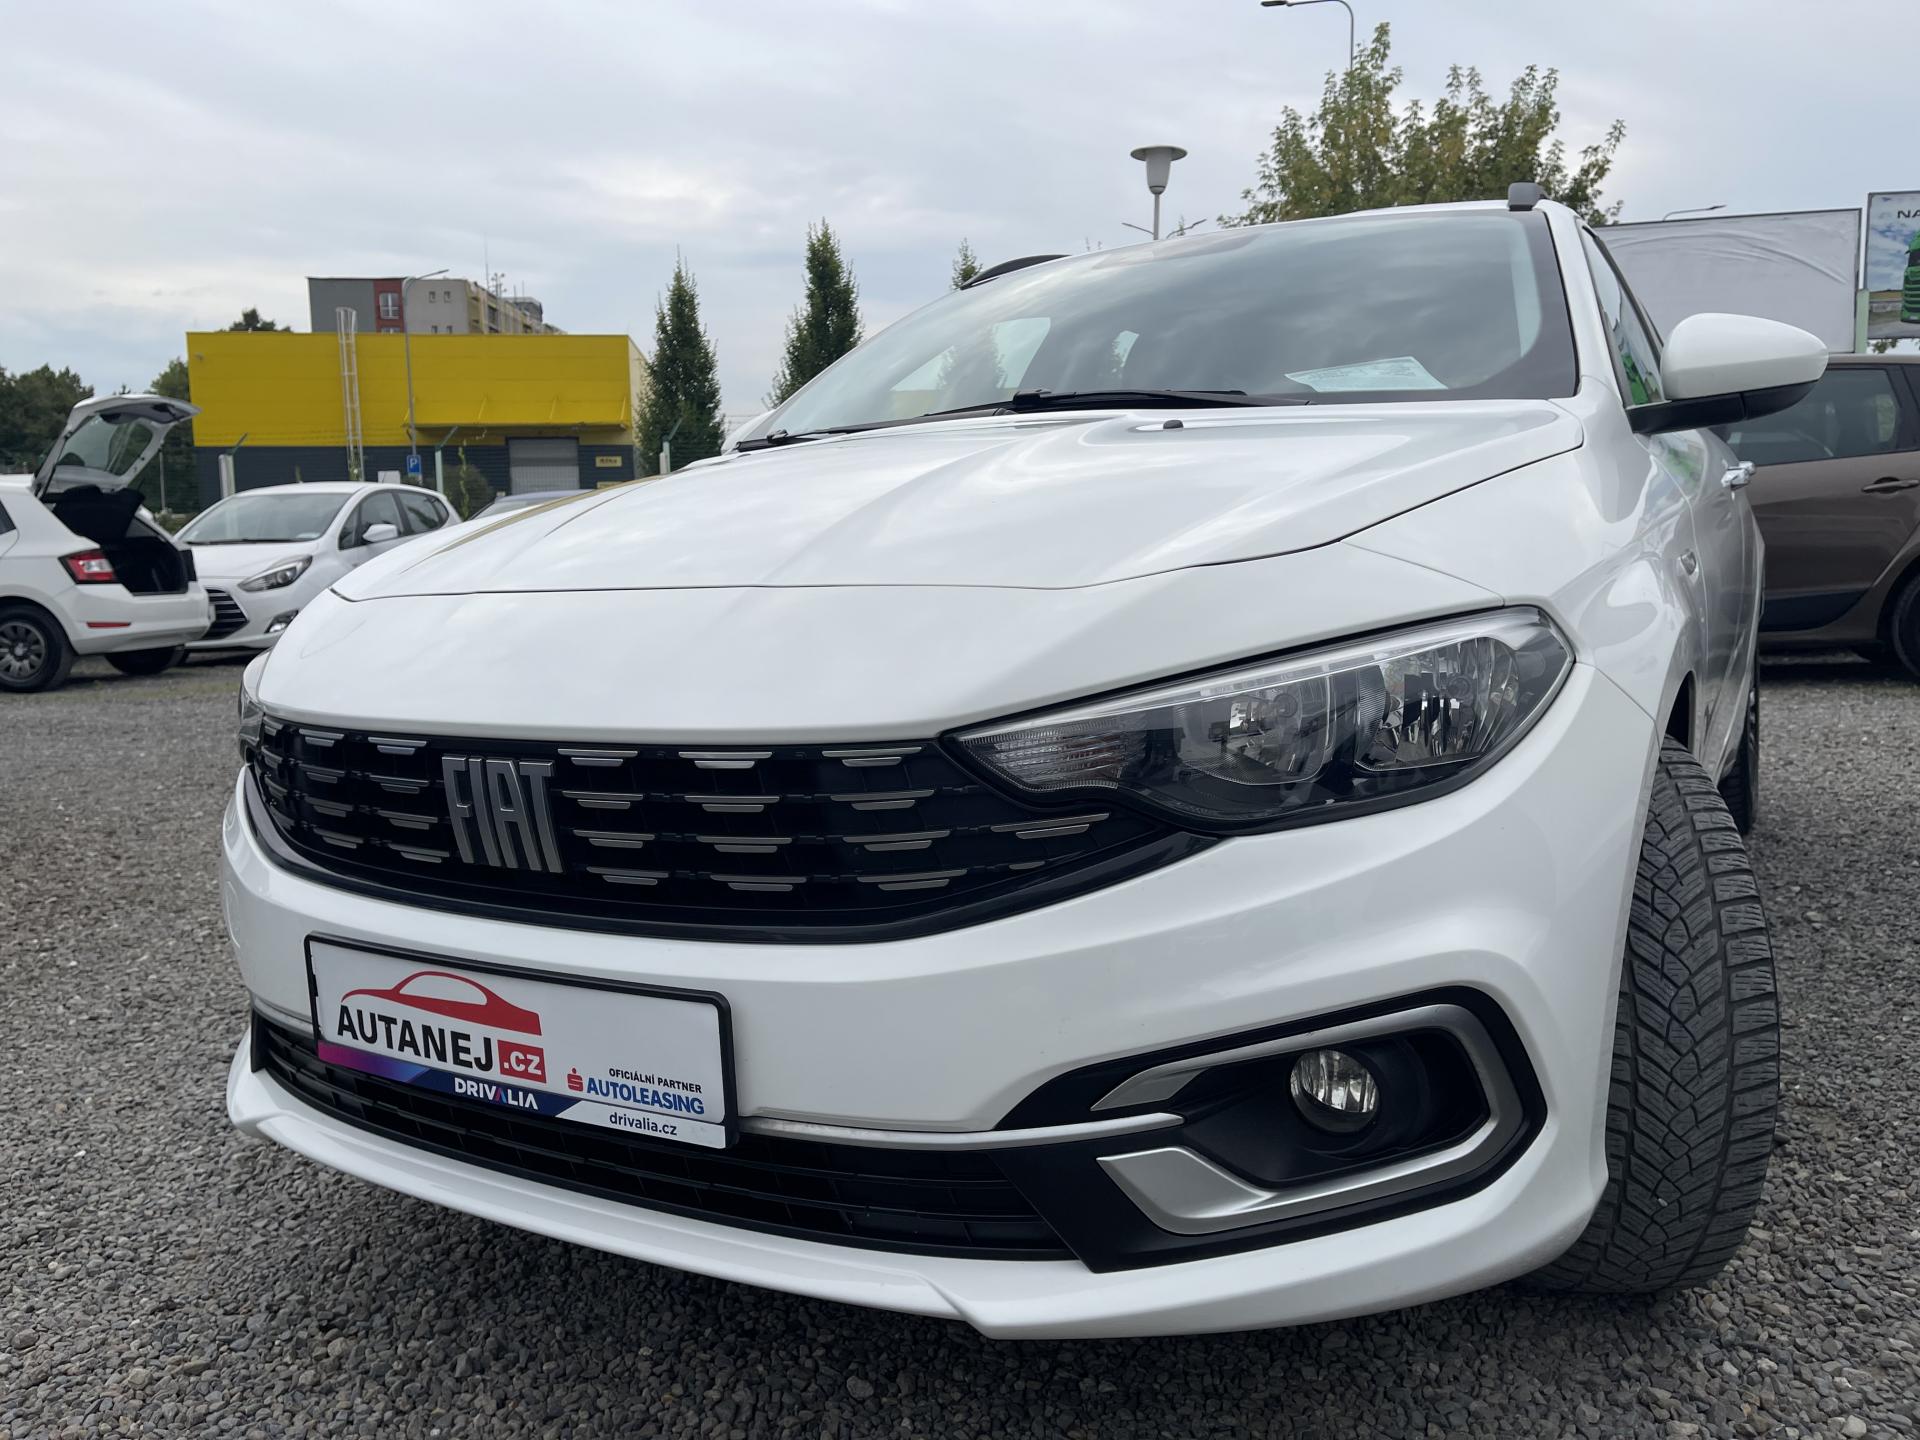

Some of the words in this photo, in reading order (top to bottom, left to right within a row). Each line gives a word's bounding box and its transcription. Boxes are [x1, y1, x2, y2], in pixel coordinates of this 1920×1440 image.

[441, 755, 564, 874] FIAT
[454, 1077, 539, 1110] DRIVALIA
[586, 1077, 705, 1115] AUTOLEASING
[608, 1067, 655, 1085] OFICIÁLNÍ
[657, 1077, 702, 1094] PARTNER
[609, 1111, 678, 1136] drivalia.cz
